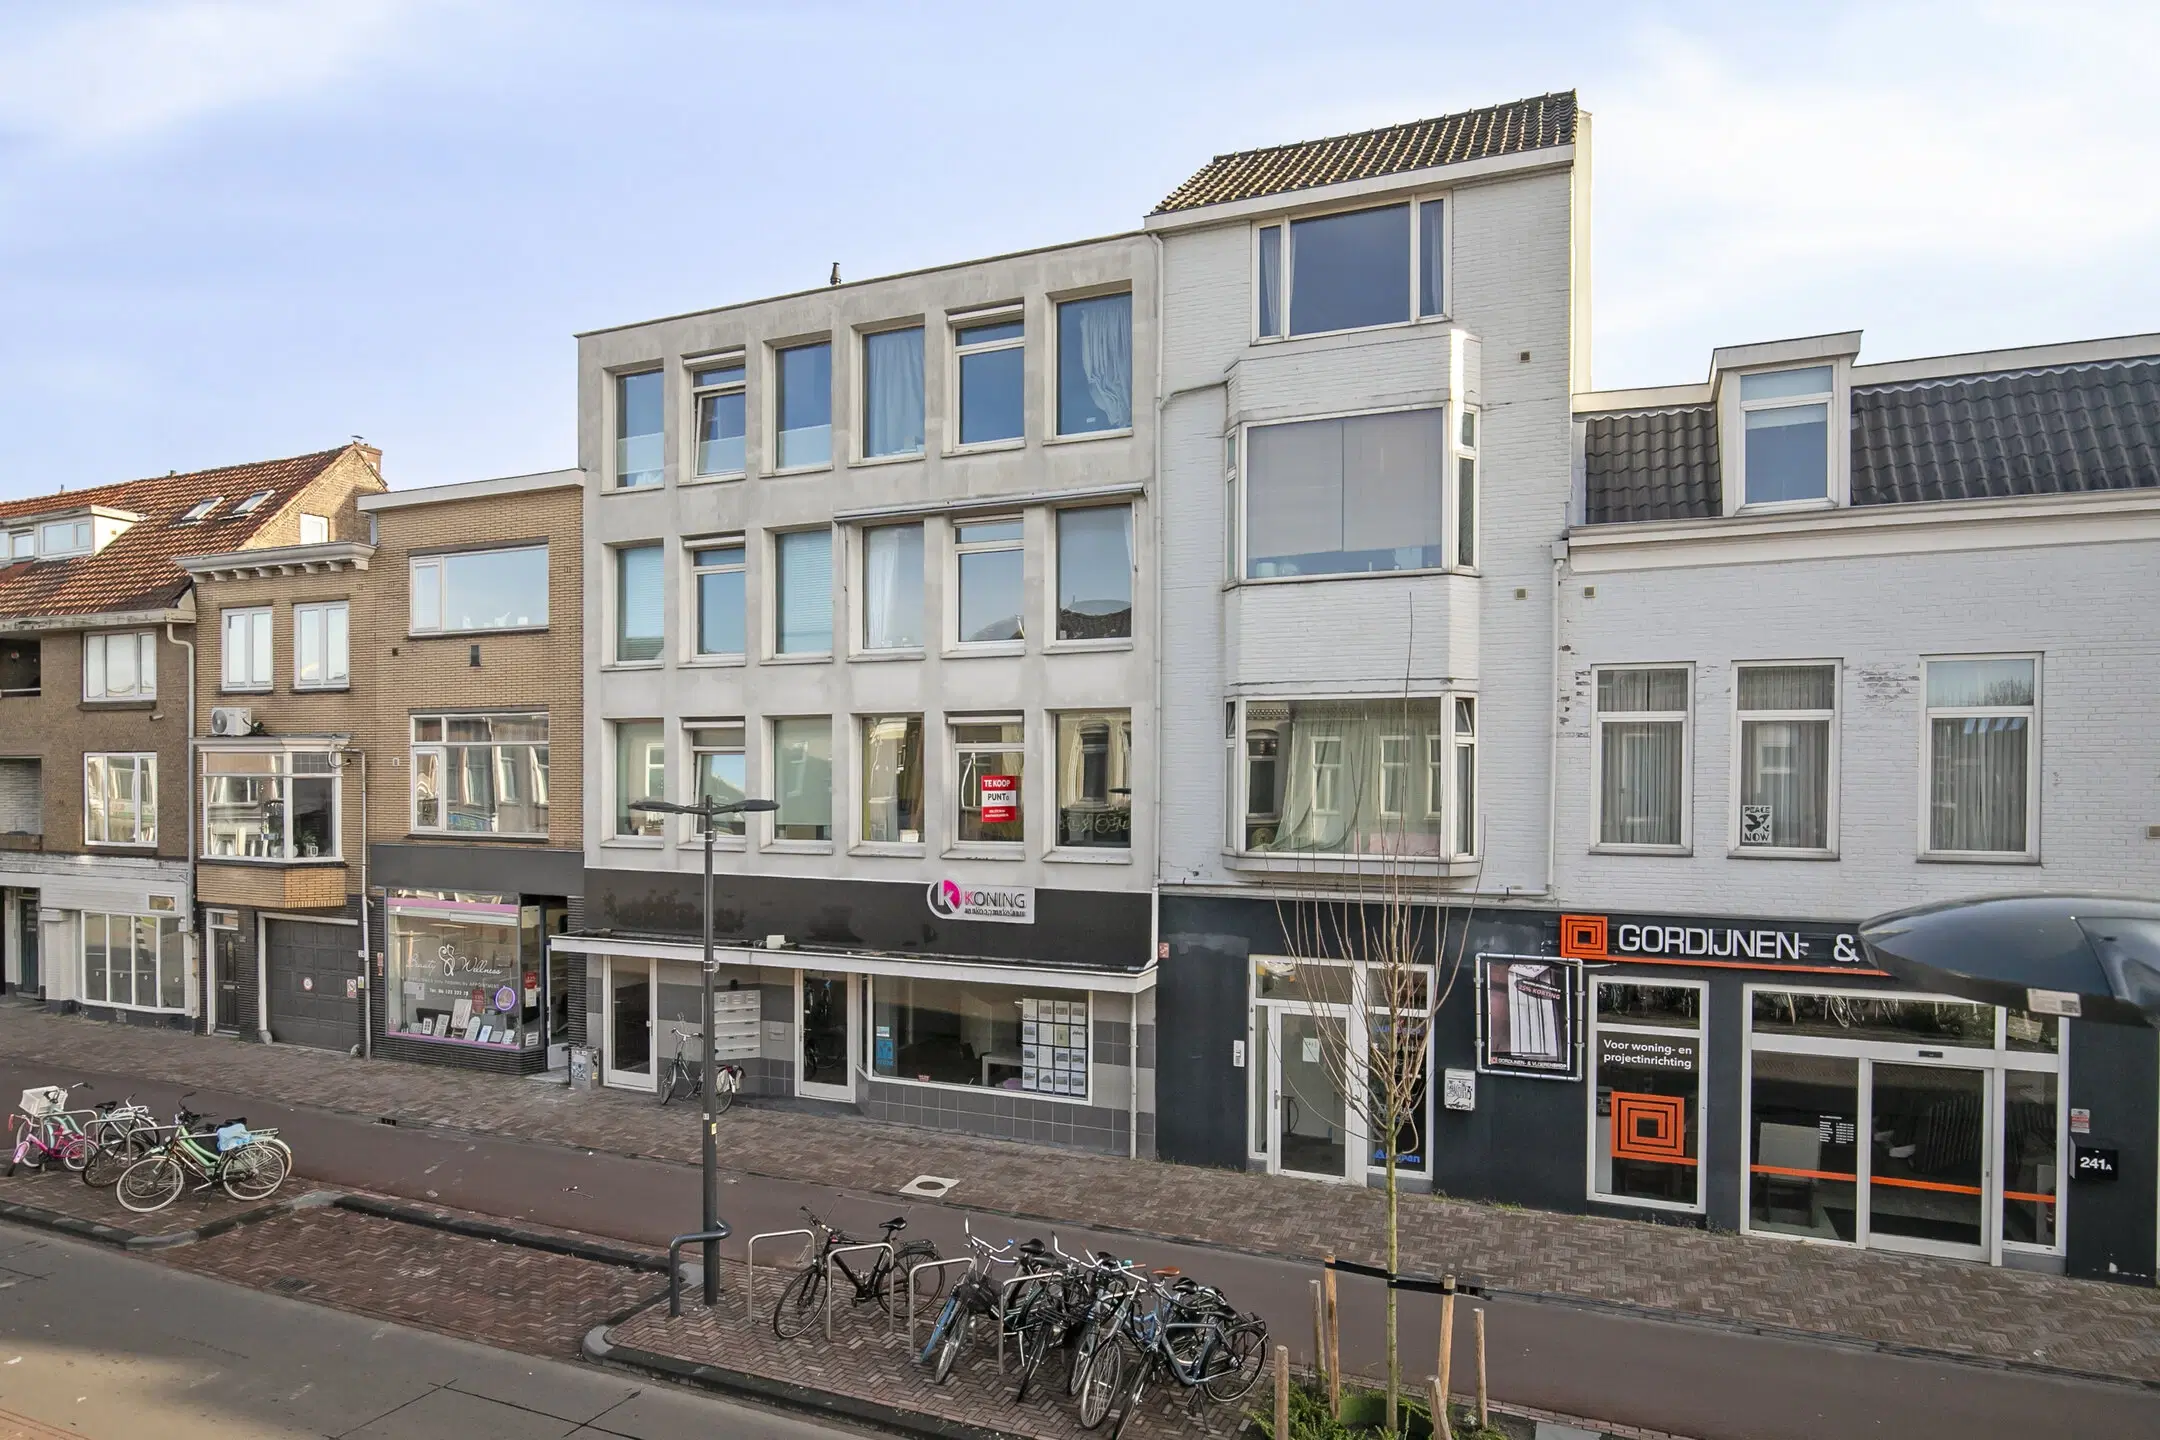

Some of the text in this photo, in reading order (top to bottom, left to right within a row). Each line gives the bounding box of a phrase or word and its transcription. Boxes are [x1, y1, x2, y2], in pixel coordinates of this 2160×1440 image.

[984, 779, 1011, 788] TE KOOP
[1744, 806, 1771, 814] PEACE
[1744, 832, 1770, 842] NOW
[964, 891, 1026, 909] KONING
[1833, 933, 1861, 962] &
[459, 956, 502, 975] Wellness
[1532, 988, 1561, 1000] KORTING
[1603, 1039, 1692, 1056] Voor woning- en
[1603, 1053, 1692, 1070] projectinrichting
